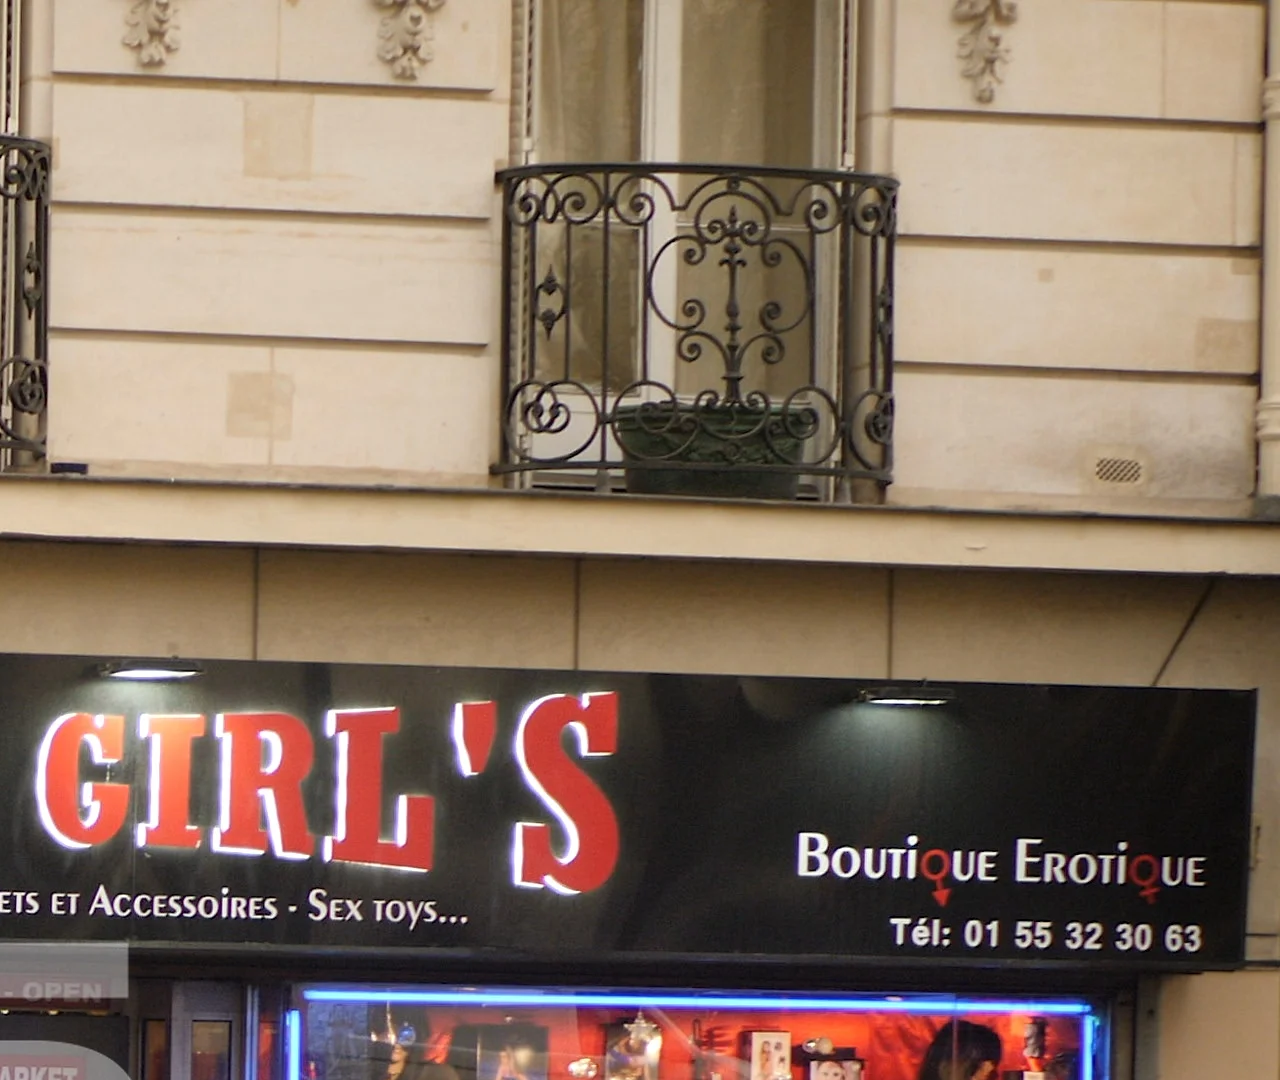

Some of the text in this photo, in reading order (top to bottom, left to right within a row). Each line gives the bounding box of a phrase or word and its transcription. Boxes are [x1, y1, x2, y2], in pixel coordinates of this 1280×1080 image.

[37, 691, 621, 896] GIRL'S
[889, 917, 1202, 952] Tél: 01 55 32 30 63
[22, 981, 103, 1003] OPEN
